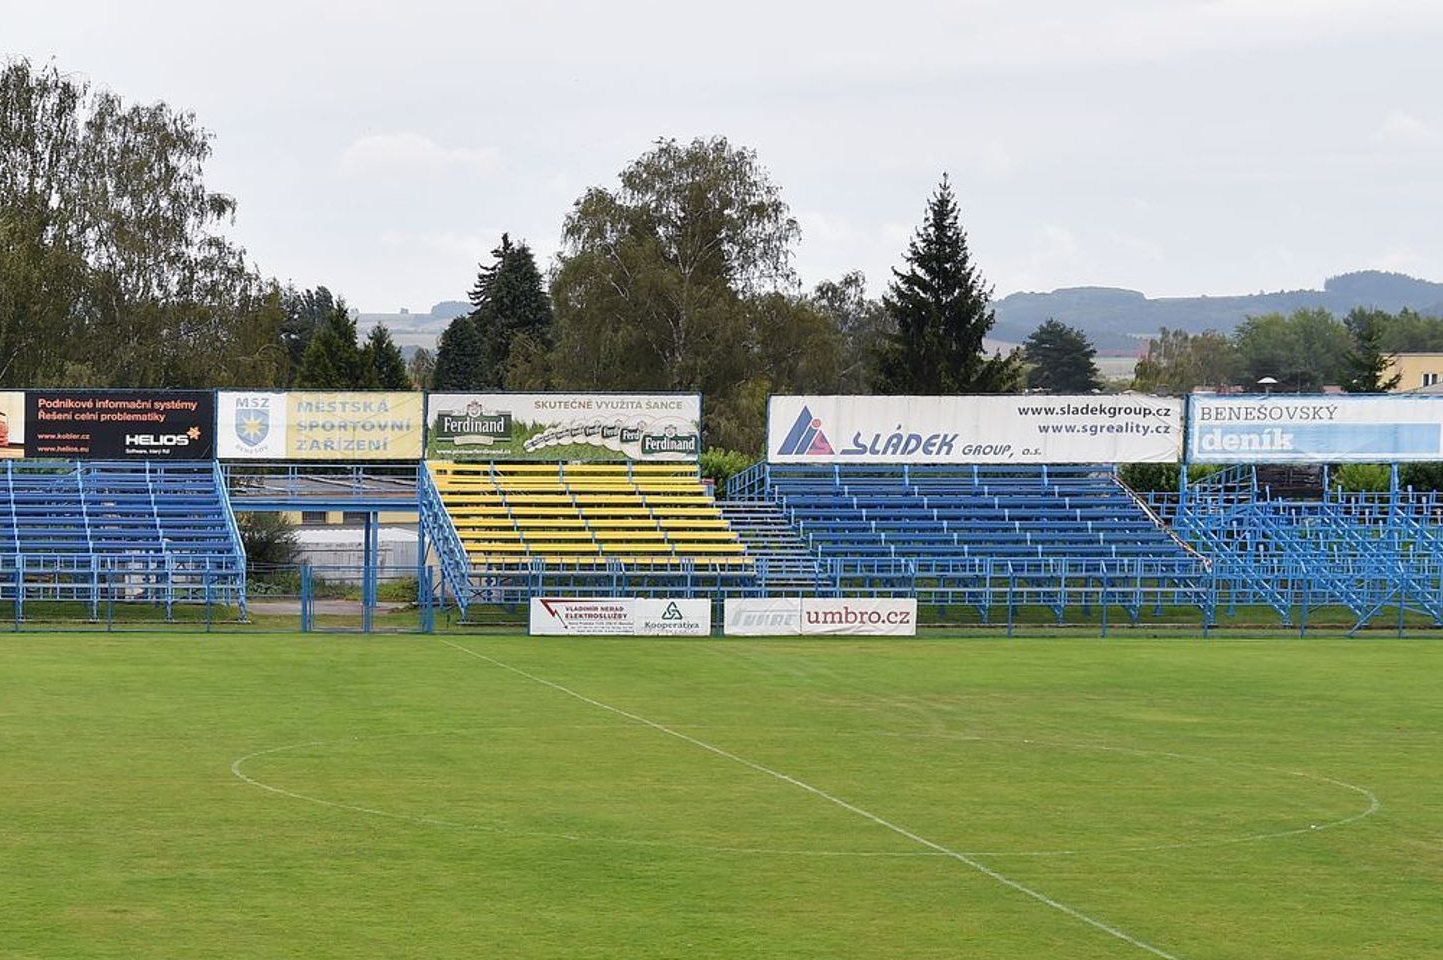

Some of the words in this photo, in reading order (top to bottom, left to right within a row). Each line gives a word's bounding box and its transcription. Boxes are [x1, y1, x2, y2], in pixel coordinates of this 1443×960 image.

[38, 399, 93, 409] Podnikové
[96, 399, 151, 409] informační
[154, 400, 198, 410] systémy
[236, 398, 270, 408] MSZ
[298, 399, 389, 412] MĚSTSKÁ
[38, 410, 72, 420] Řešení
[74, 411, 98, 420] celní
[100, 412, 165, 422] problematiky
[1018, 404, 1171, 418] www.sladekgroup.cz
[1200, 404, 1338, 421] BENEŠOVSKÝ
[297, 419, 410, 432] SPORTOVNÍ
[444, 416, 504, 433] Ferdinand
[1038, 422, 1171, 436] www.sgreality.cz
[126, 434, 189, 445] HELIOS
[298, 437, 388, 450] ZAŘÍZENÍ
[645, 437, 696, 451] Ferdinand
[840, 424, 959, 456] SLÁDEK
[1202, 427, 1294, 450] deník
[806, 606, 912, 624] umbro.cz
